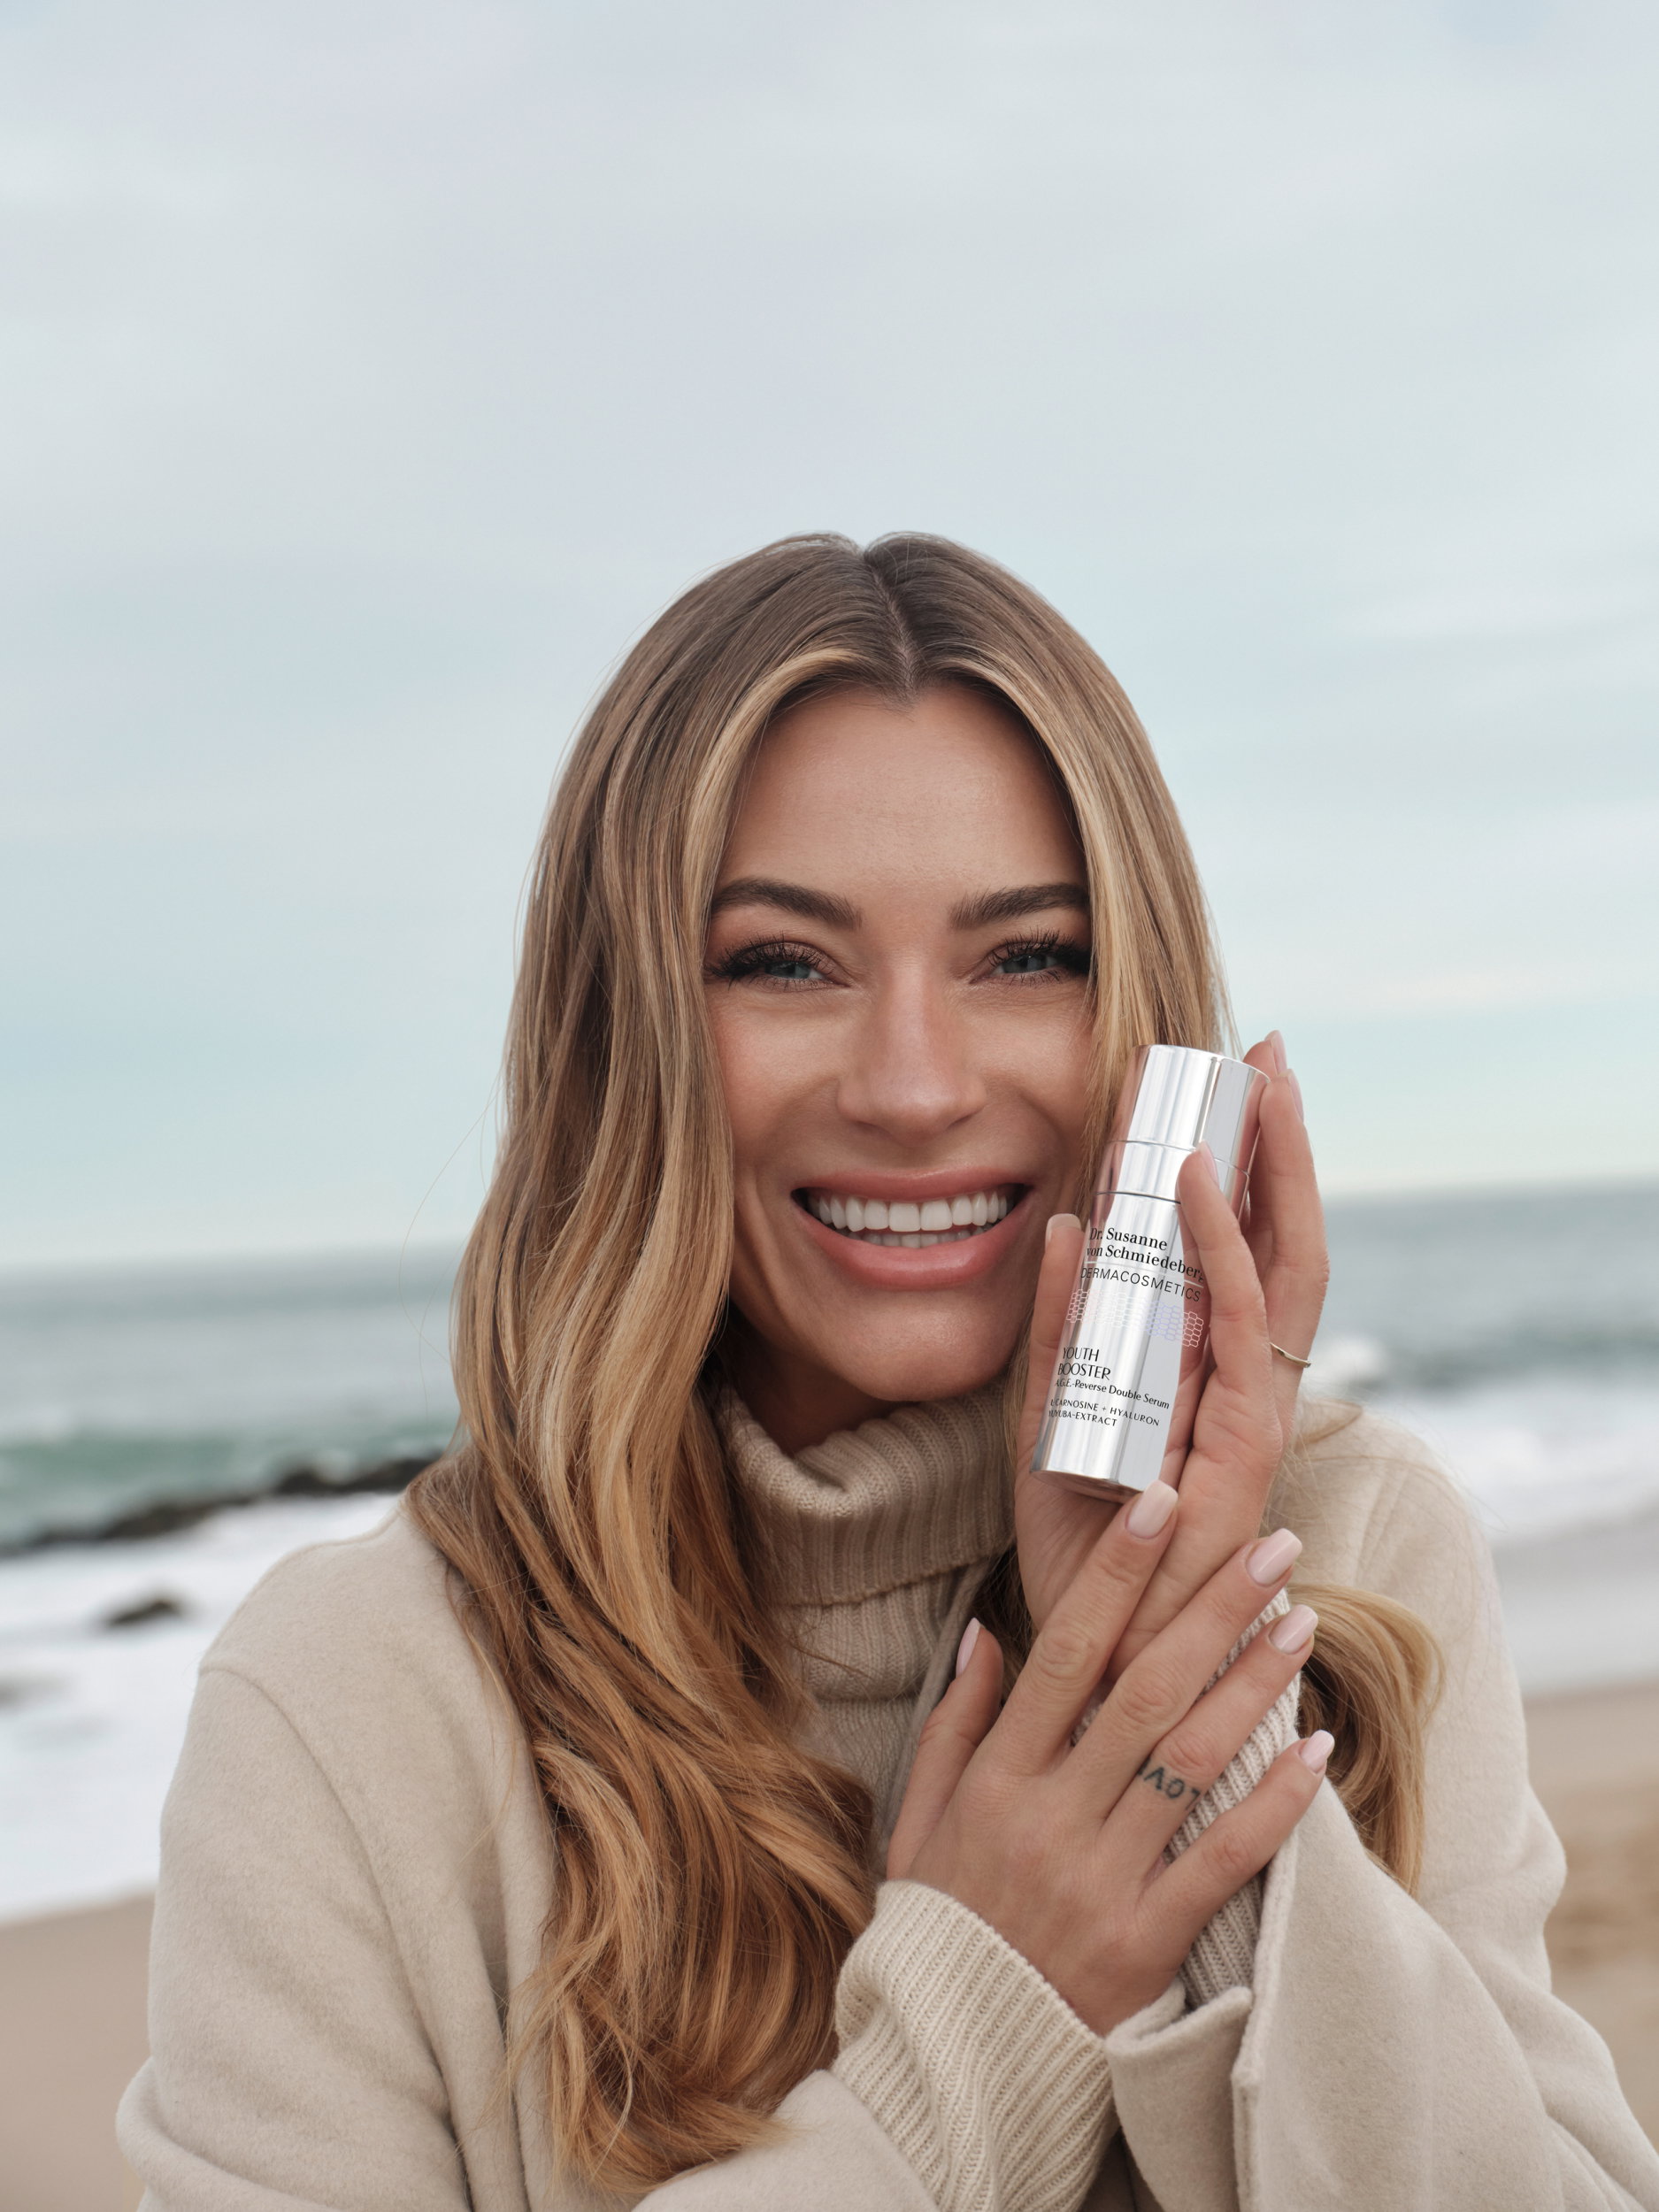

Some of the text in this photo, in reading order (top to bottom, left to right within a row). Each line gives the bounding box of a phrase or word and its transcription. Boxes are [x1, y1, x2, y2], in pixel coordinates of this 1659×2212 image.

[1089, 1227, 1168, 1251] Dr. Susanne
[1087, 1247, 1103, 1256] von
[1080, 1267, 1201, 1302] DERMACOSMETICS
[1063, 1347, 1100, 1362] YOUTH
[1057, 1363, 1111, 1380] BOOSTER
[1109, 1385, 1141, 1401] Double
[1142, 1394, 1170, 1409] Serum
[1110, 1407, 1160, 1426] HYALURON
